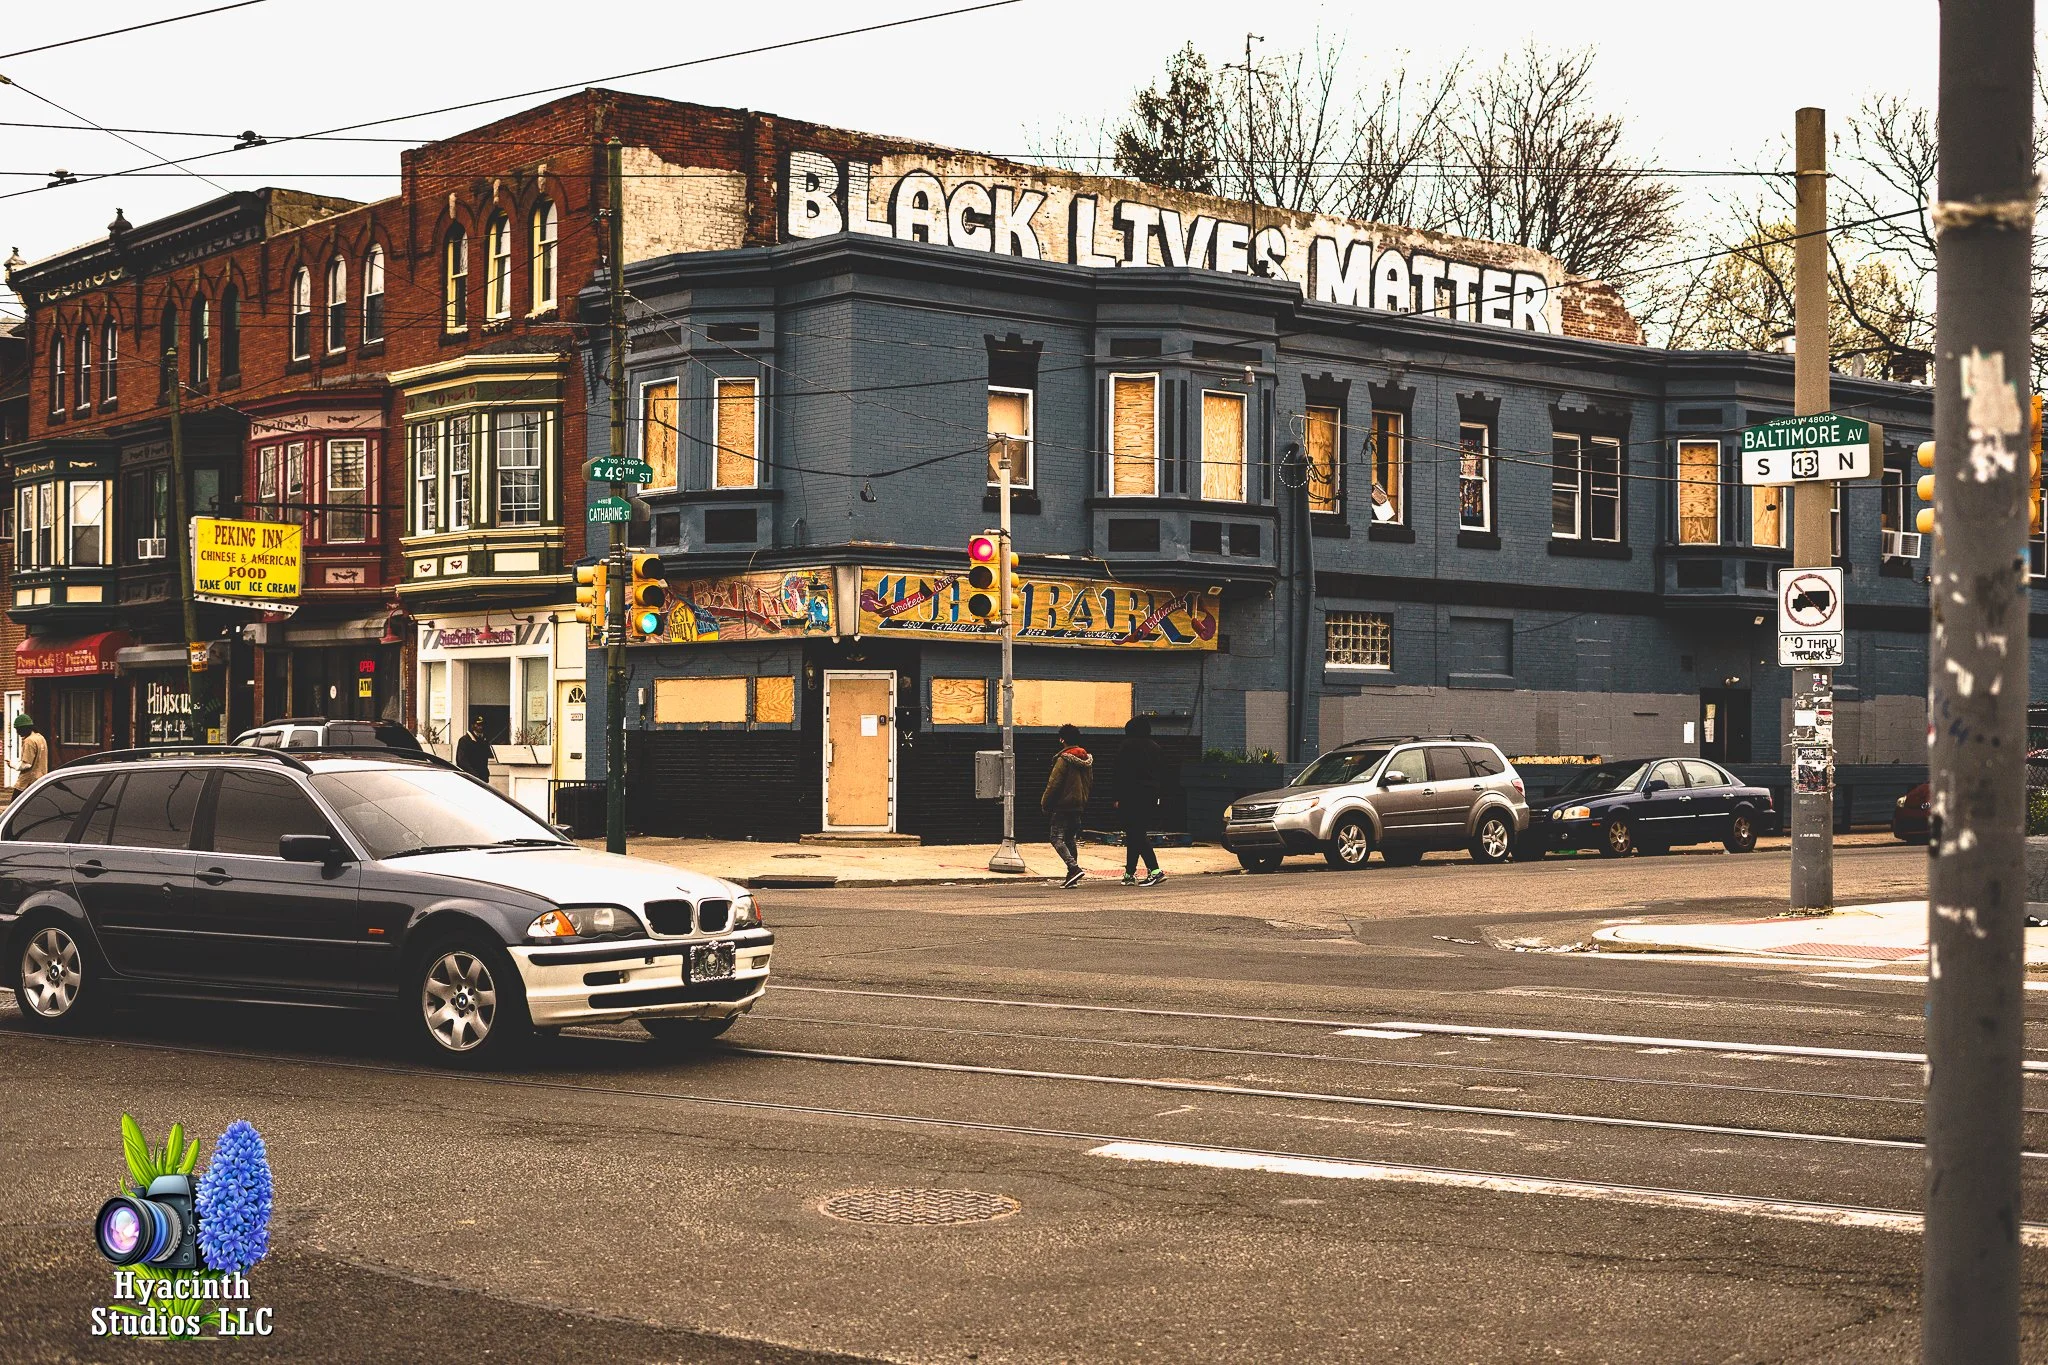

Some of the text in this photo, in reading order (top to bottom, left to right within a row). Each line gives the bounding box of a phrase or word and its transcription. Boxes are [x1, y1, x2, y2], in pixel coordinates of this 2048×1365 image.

[786, 150, 1553, 335] BLACK LIVES MATTER
[1808, 415, 1830, 424] 4800
[1744, 424, 1863, 449] BALTIMORE AV
[1757, 451, 1854, 476] S 13 N
[639, 472, 652, 483] ST
[588, 506, 631, 521] CATHARINE ST
[214, 524, 284, 549] PEKING INN
[200, 550, 298, 567] CHINESE & AMERICAN
[228, 566, 267, 580] FOOD
[199, 579, 297, 594] TAKE OUT ICE CREAM
[901, 620, 987, 633] 4901 CATHARINE
[1025, 628, 1047, 636] BEER
[1806, 638, 1837, 649] THRU
[359, 660, 376, 673] OPEN
